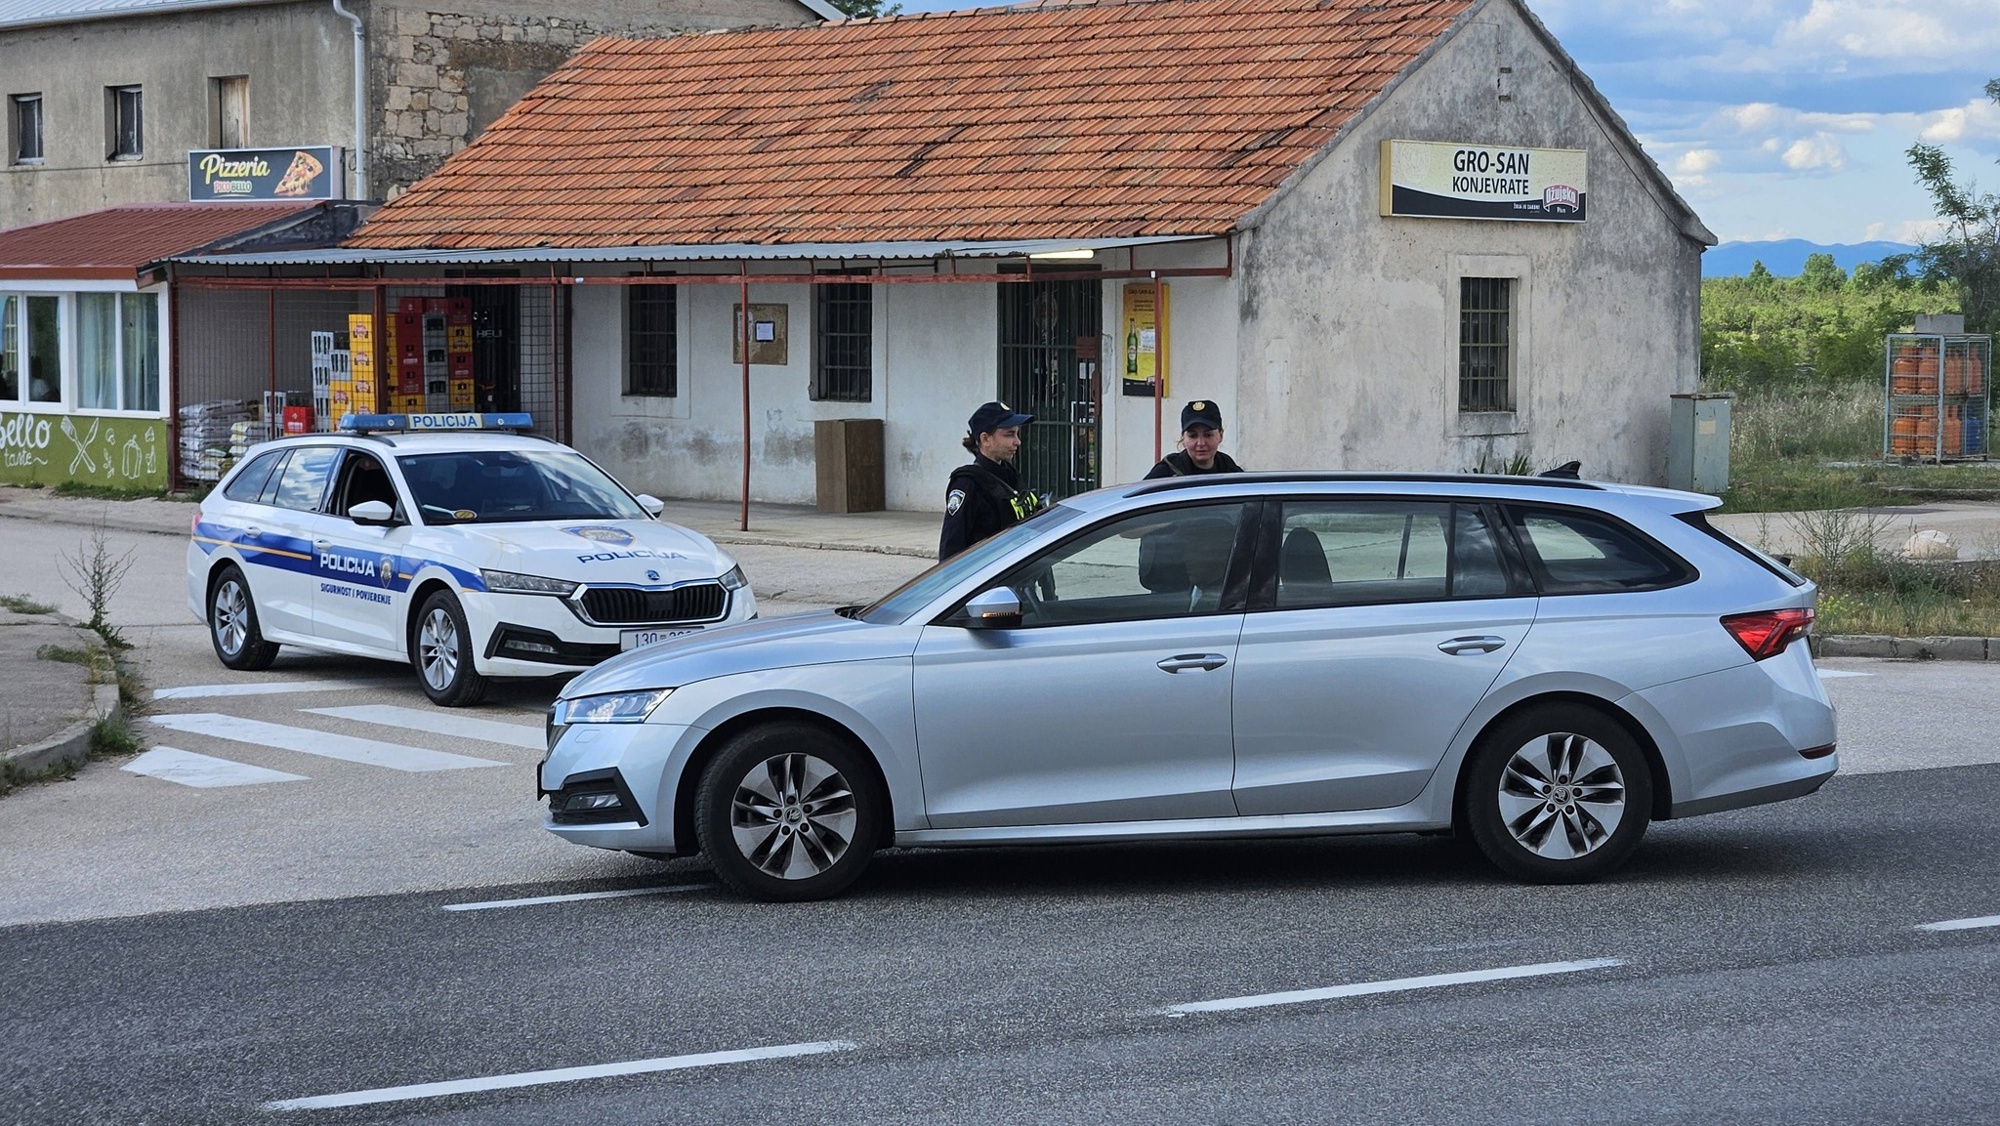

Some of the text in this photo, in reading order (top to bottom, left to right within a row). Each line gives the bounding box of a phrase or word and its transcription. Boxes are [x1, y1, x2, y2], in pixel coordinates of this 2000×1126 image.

[200, 154, 270, 184] Pizzeria
[1454, 150, 1530, 175] GRO-SAN
[214, 181, 252, 193] PICO BELLO
[1452, 176, 1529, 195] KONJEVRATE
[413, 415, 478, 428] POLICIJA
[4, 448, 32, 468] taste
[320, 553, 375, 577] POLICIJA
[577, 550, 688, 564] POLICIJA
[320, 582, 352, 598] SIGURNOST
[356, 589, 391, 605] POVJERENJE
[635, 632, 658, 648] 130
